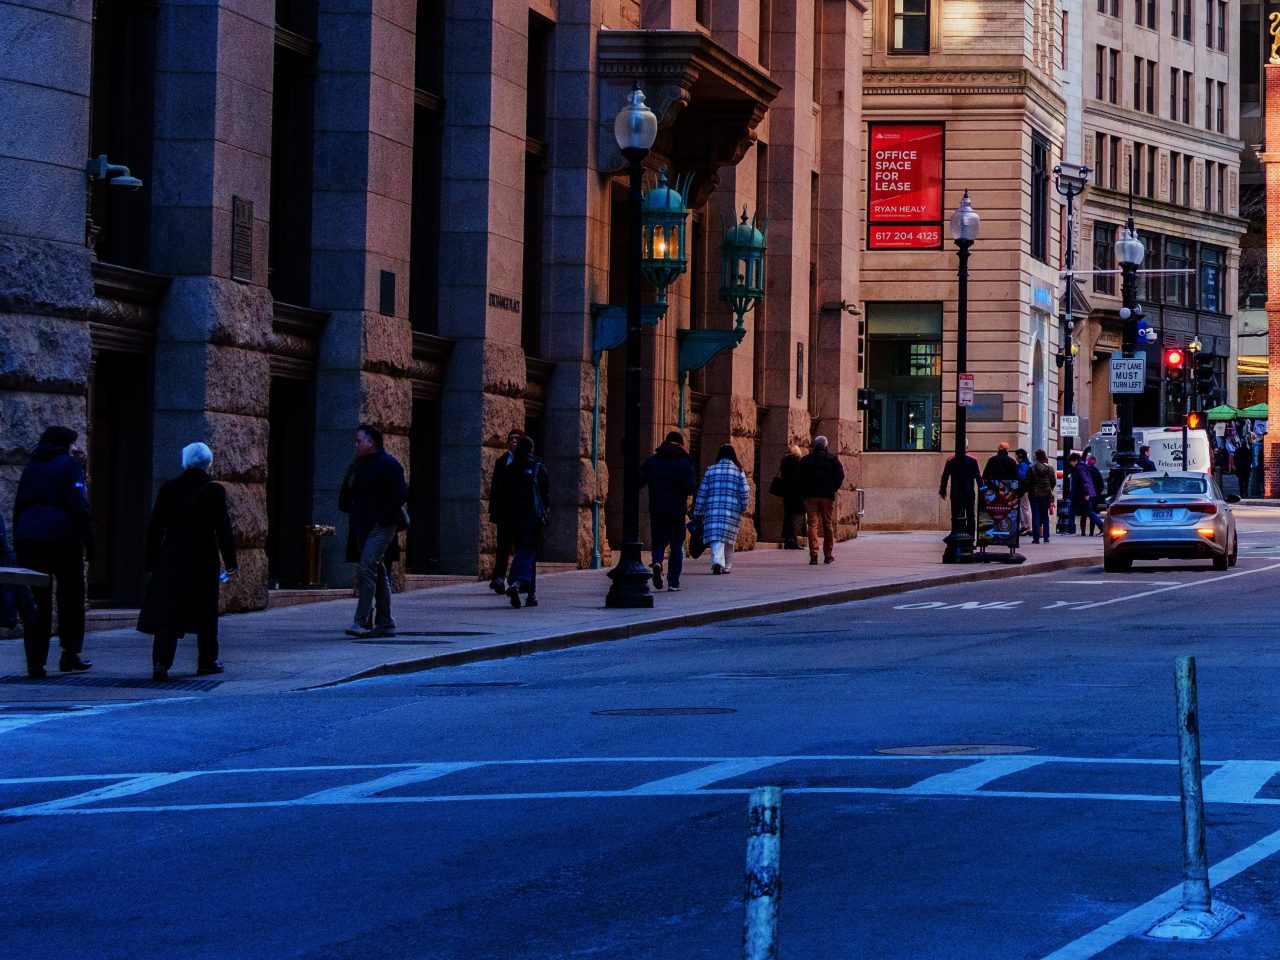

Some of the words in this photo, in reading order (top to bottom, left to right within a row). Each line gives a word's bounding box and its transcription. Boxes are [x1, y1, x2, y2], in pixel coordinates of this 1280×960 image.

[876, 150, 917, 160] OFFICE
[876, 162, 911, 170] SPACE
[876, 172, 898, 180] FOR
[876, 182, 911, 190] LEASE
[876, 232, 891, 240] 617
[894, 232, 913, 240] 204
